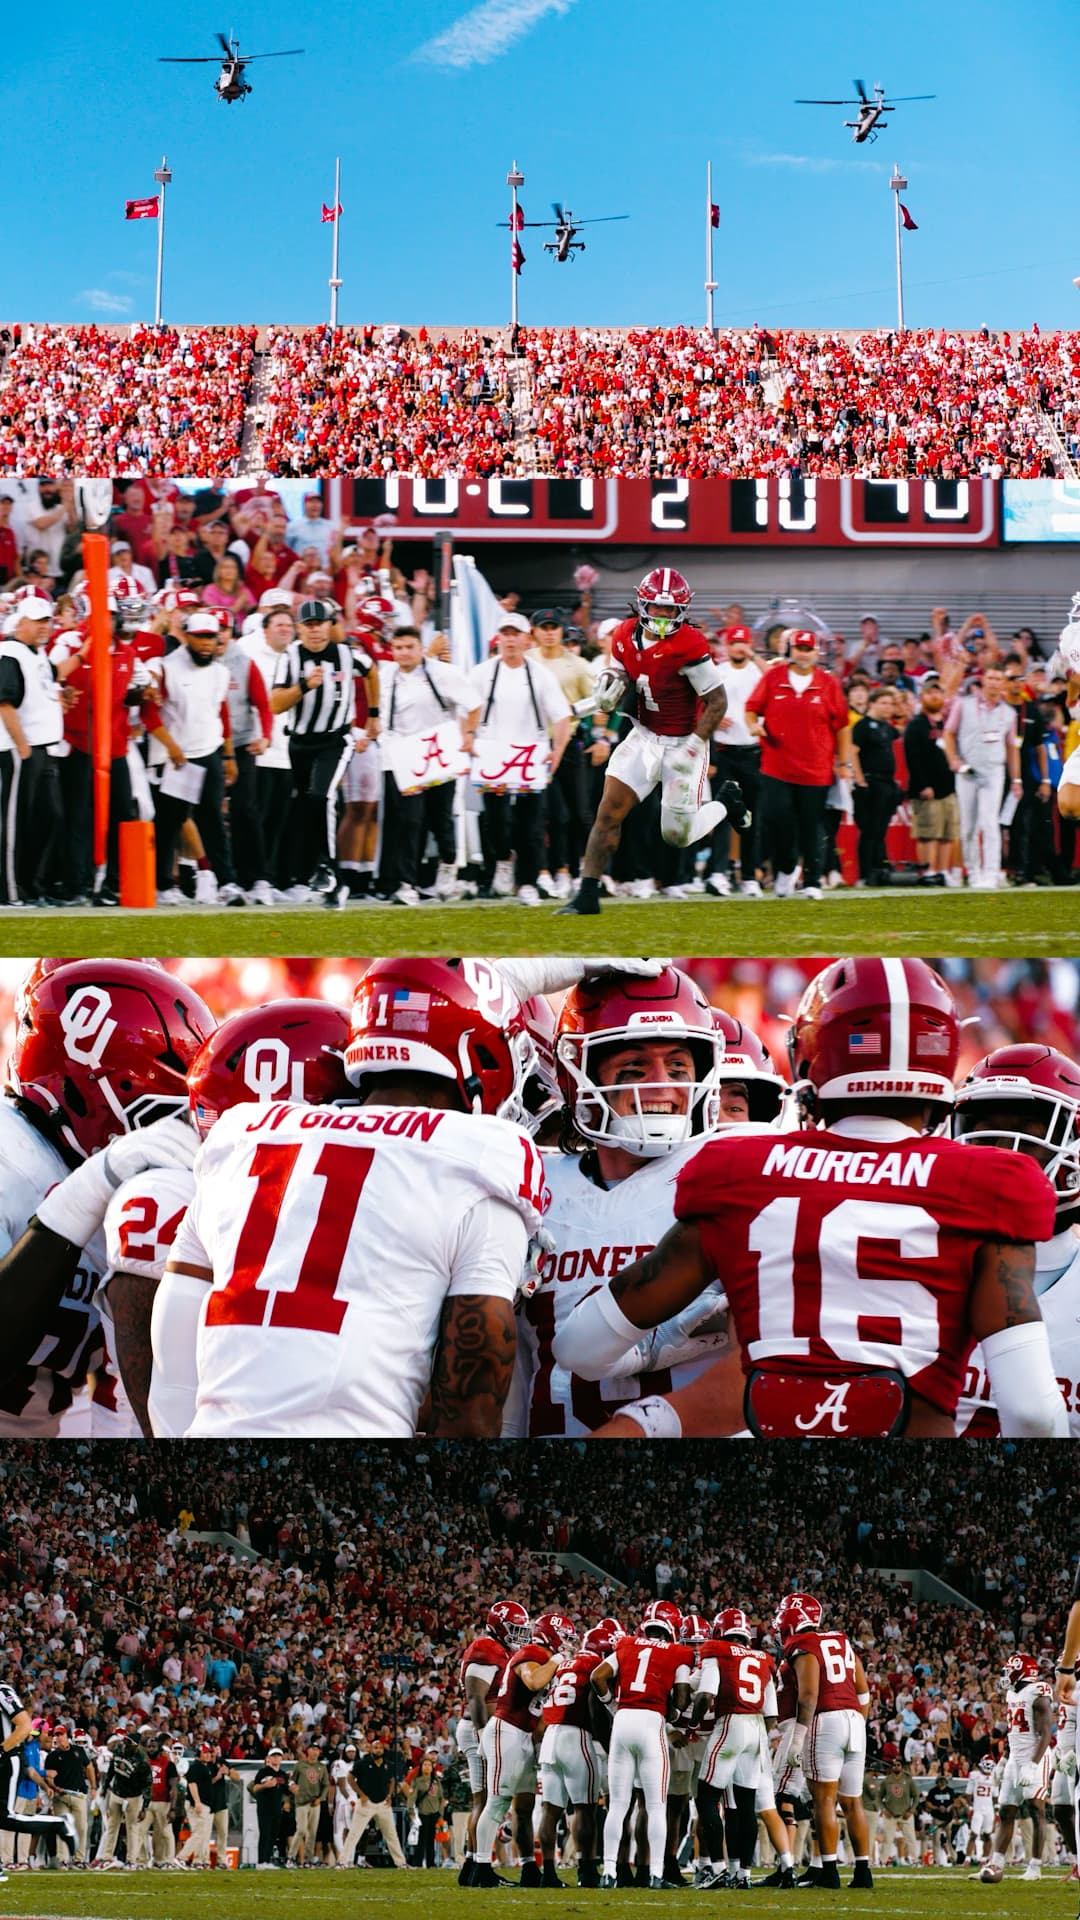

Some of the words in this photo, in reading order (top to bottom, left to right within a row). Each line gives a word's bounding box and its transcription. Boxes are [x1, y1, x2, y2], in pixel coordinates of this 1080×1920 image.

[636, 673, 660, 712] 1
[411, 732, 449, 777] A
[480, 744, 537, 782] A
[847, 1081, 915, 1093] CRIMSON
[918, 1082, 946, 1096] TIDE
[762, 1144, 937, 1188] MORGAN
[205, 1142, 376, 1335] 11
[748, 1196, 940, 1378] 16
[795, 1381, 849, 1432] A
[630, 1647, 653, 1692] 1
[739, 1656, 761, 1704] 5
[820, 1638, 856, 1684] 64
